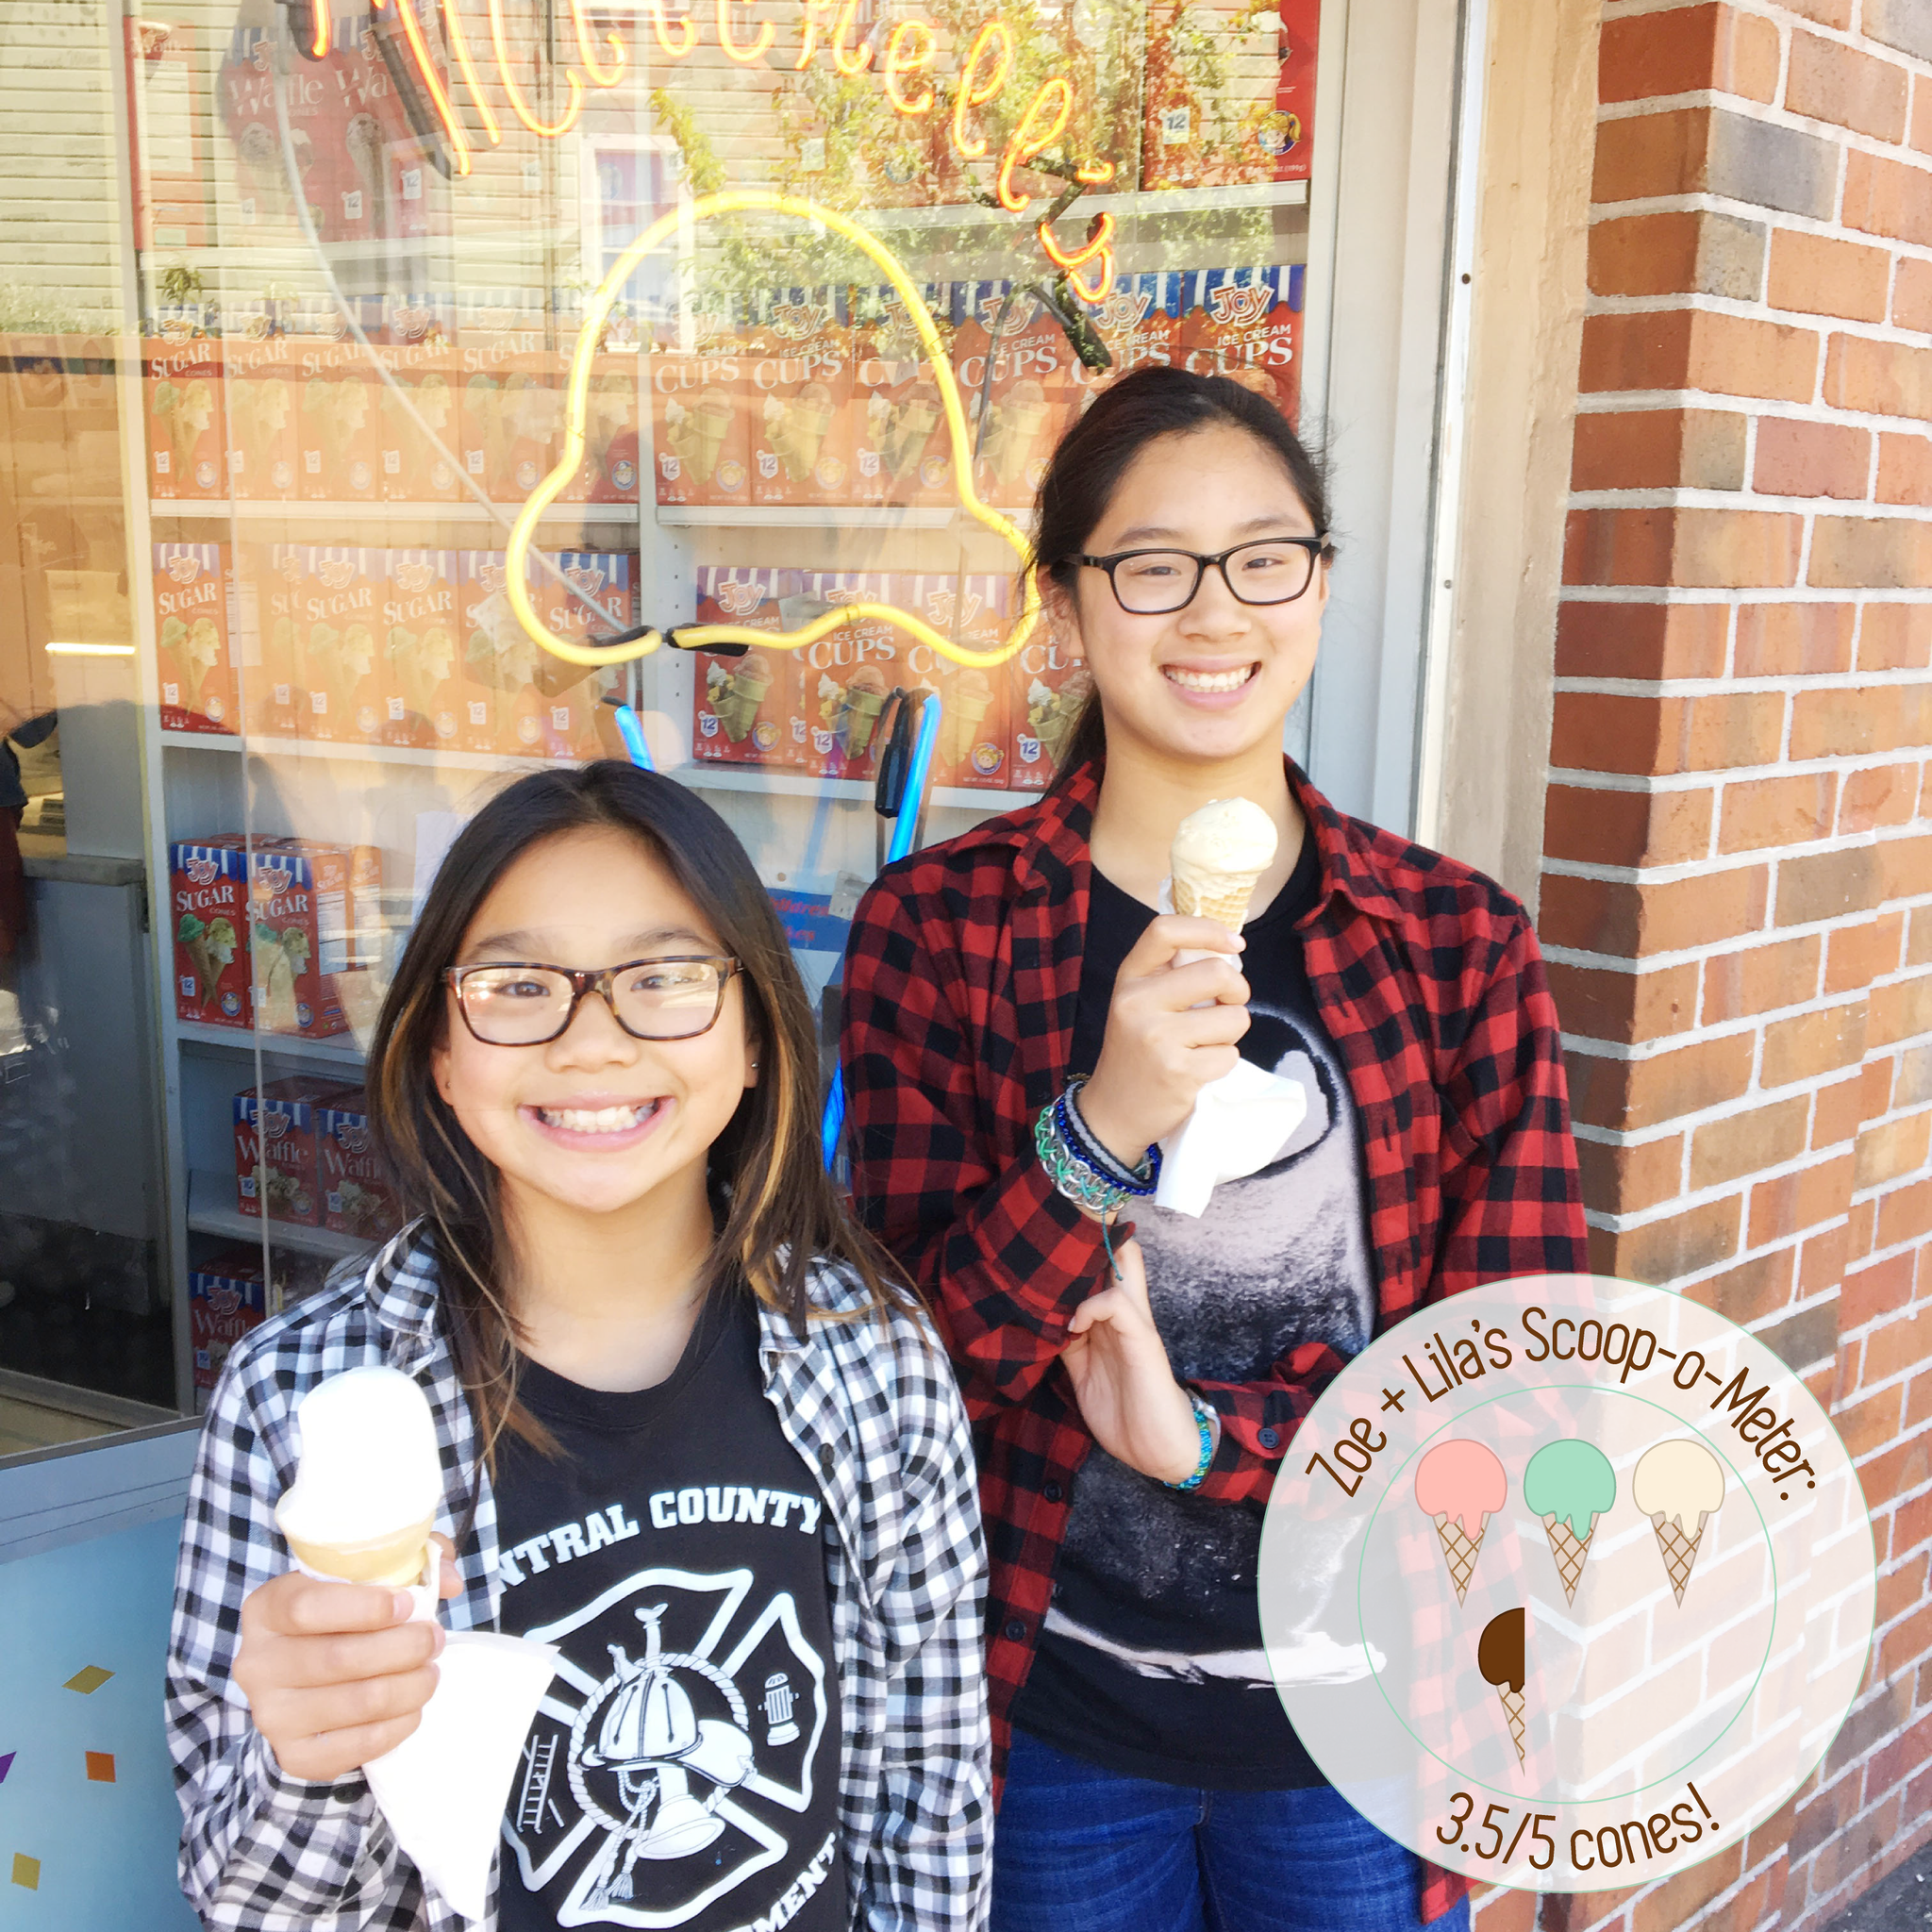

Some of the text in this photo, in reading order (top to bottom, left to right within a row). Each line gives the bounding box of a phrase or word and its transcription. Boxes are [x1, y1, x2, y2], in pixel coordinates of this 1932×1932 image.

[1166, 114, 1187, 130] 12
[405, 175, 419, 189] 12
[347, 195, 359, 208] 12
[993, 333, 1056, 355] CE CREAM
[1106, 328, 1171, 352] CE CREAM
[1217, 324, 1291, 347] ICE CREAM
[151, 342, 211, 381] SUGAR
[226, 340, 289, 379] SUGAR
[379, 336, 450, 375] SUGAR
[464, 332, 536, 374] SUGAR
[960, 345, 1058, 388] CUPS
[1186, 337, 1293, 378] CUPS
[655, 357, 741, 394] CUPS
[754, 351, 842, 390] CUPS
[662, 458, 678, 472] 12
[760, 458, 775, 471] 12
[860, 456, 877, 469] 12
[479, 563, 507, 595] Jo
[158, 582, 217, 615] SUGAR
[306, 587, 373, 622] SUGAR
[383, 591, 453, 625] SUGAR
[834, 625, 893, 641] ICE CREAM
[808, 636, 896, 670] CUPS
[702, 717, 716, 730] 12
[815, 733, 830, 746] 12
[1022, 741, 1038, 756] 12
[176, 885, 234, 913] SUGAR
[209, 907, 236, 916] CONES
[245, 893, 308, 923] SUGAR
[183, 979, 193, 990] 12
[237, 1135, 308, 1164] Waffle
[648, 1486, 822, 1536] COUNTY
[731, 1830, 837, 1932] MENT
